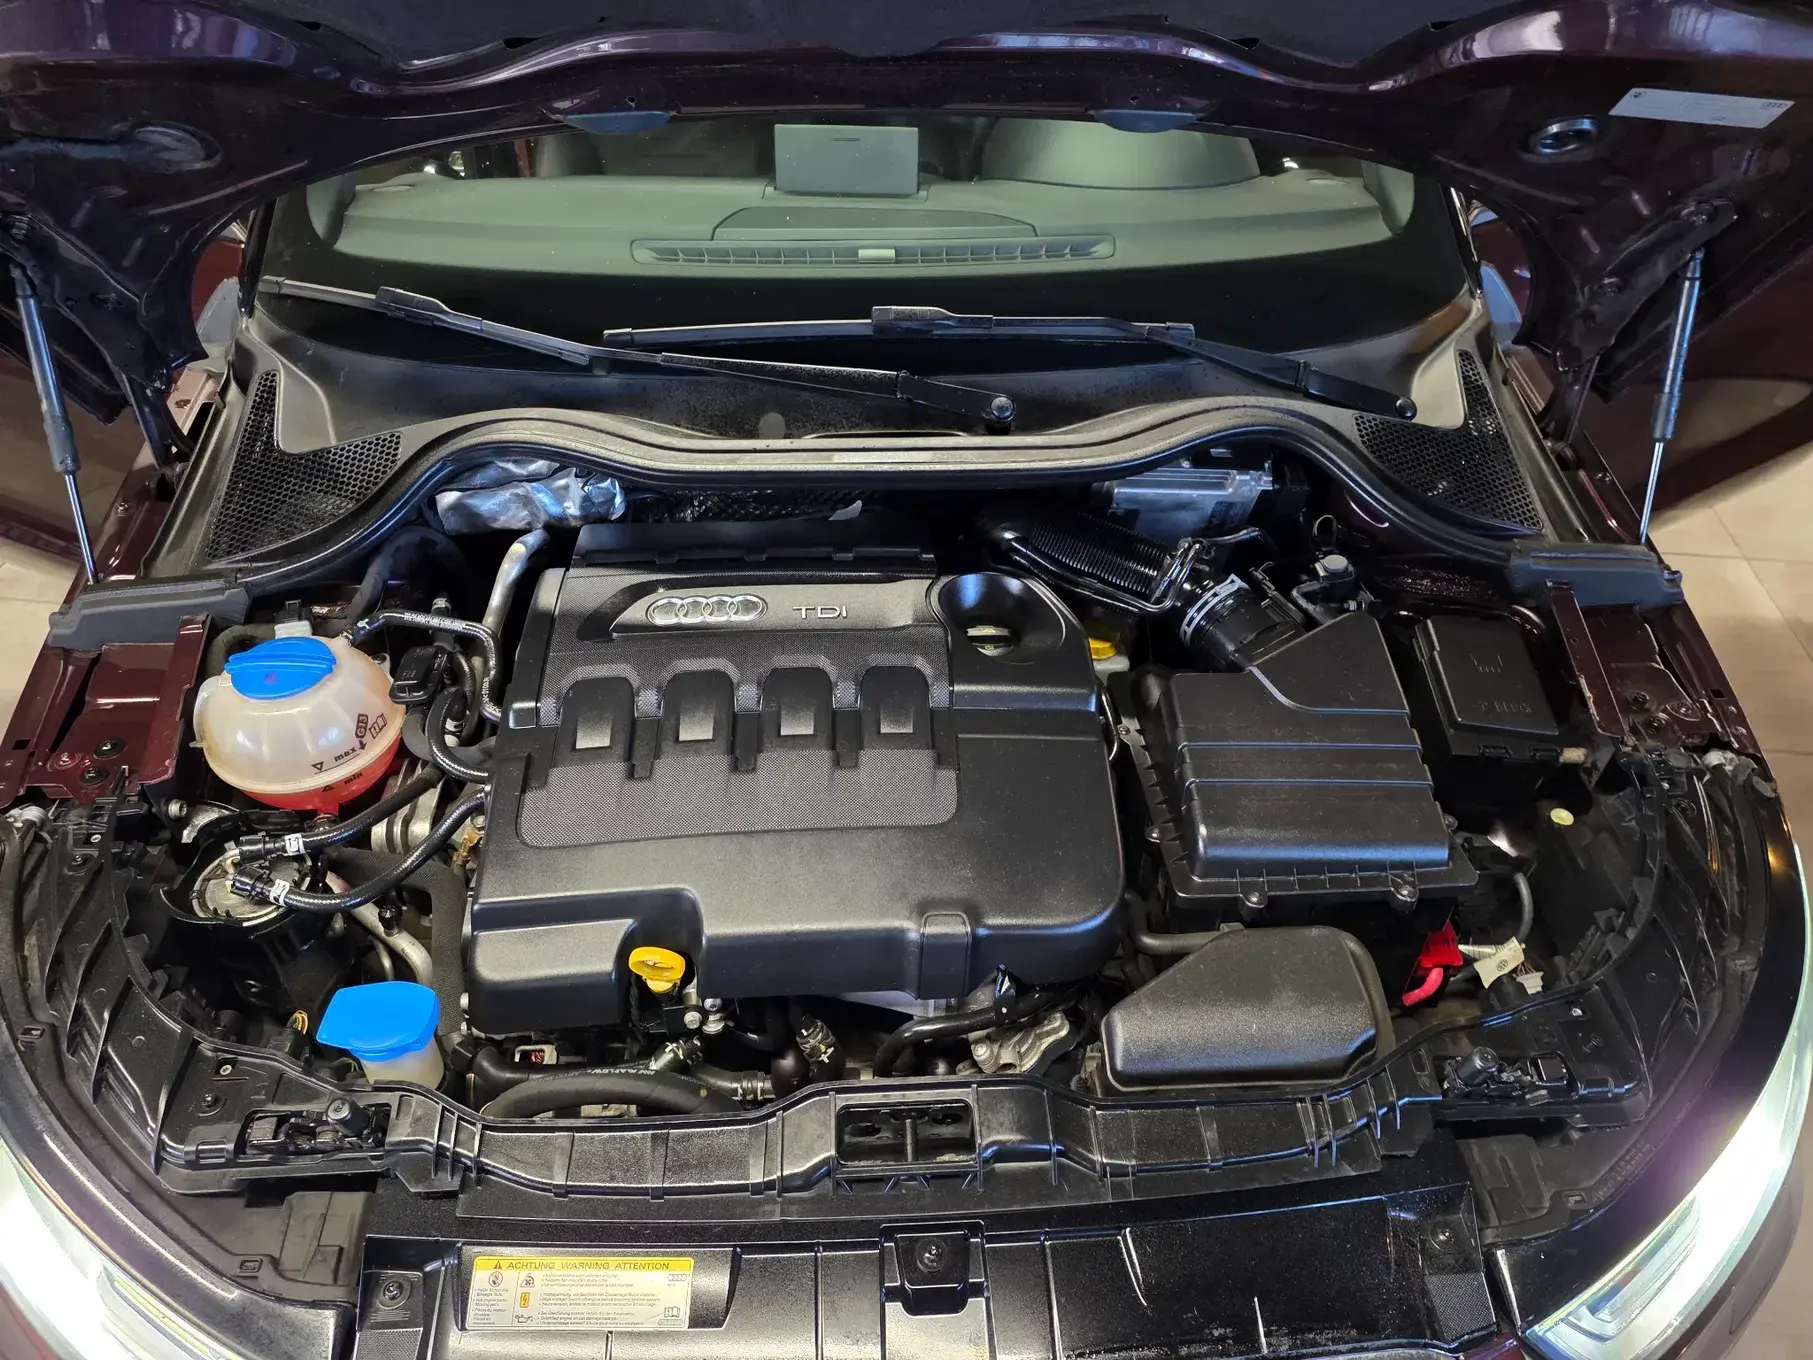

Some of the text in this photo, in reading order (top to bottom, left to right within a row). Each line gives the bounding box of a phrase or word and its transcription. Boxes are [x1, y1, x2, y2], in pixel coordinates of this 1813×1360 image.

[792, 605, 847, 619] TDI
[334, 747, 358, 762] max
[507, 1261, 670, 1270] ACHTUNG WARNING ATTENTION
